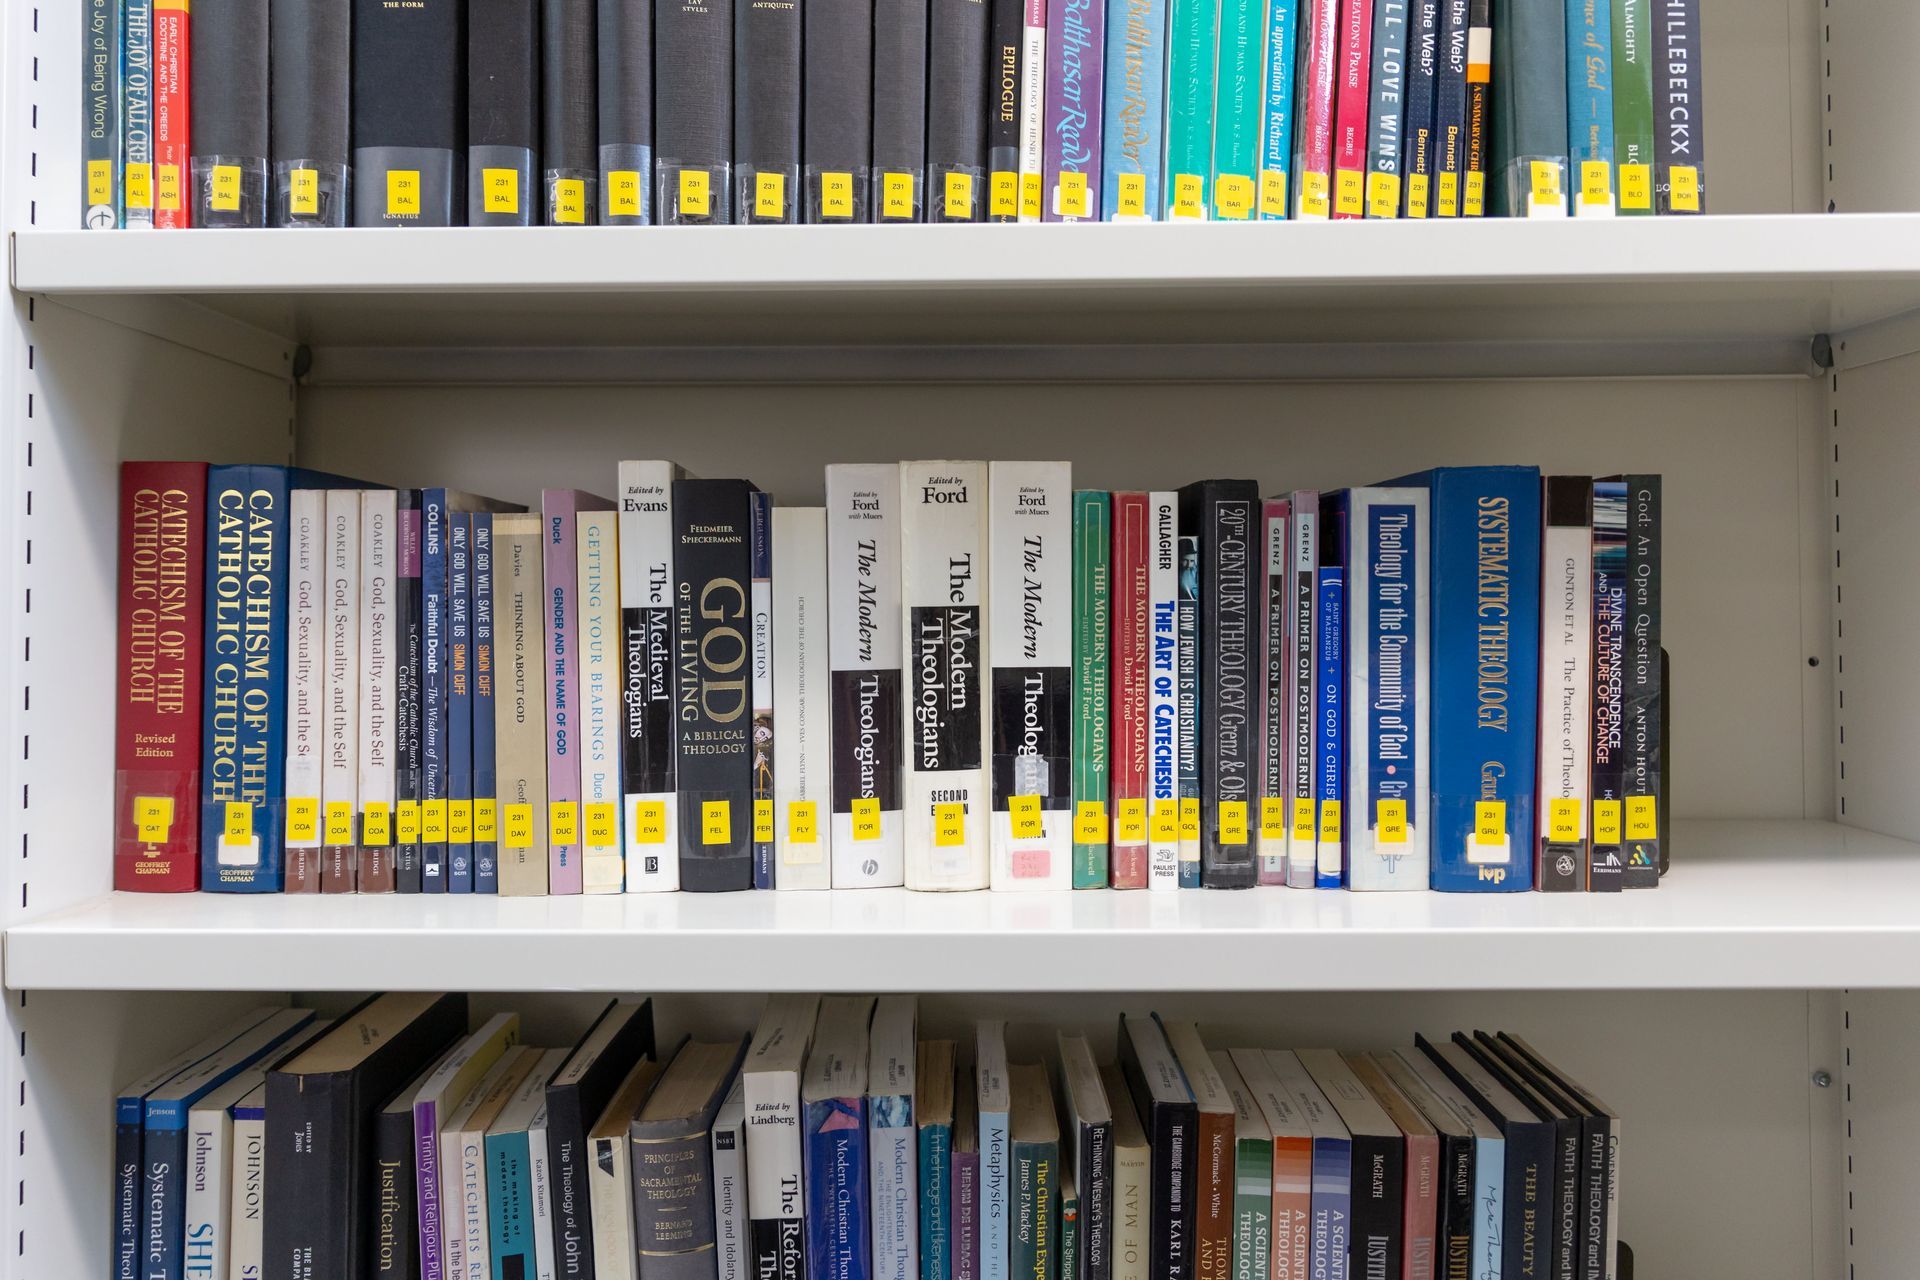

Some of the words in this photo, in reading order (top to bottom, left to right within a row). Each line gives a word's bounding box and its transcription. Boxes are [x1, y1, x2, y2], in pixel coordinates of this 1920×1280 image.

[93, 11, 108, 32] Joy
[169, 16, 177, 46] EARLY
[1276, 6, 1287, 22] An
[1422, 4, 1434, 27] the
[95, 38, 107, 54] of
[159, 17, 168, 62] DOCTRINE
[1272, 26, 1286, 92] appreciation
[1420, 33, 1434, 77] Web?
[92, 55, 108, 90] Being
[159, 64, 168, 82] AND
[159, 85, 168, 100] THE
[169, 50, 177, 95] CHRISTIAN
[1001, 46, 1015, 122] EPILOGUE
[1382, 48, 1400, 103] LOVE
[90, 92, 105, 139] Wrong
[1271, 94, 1282, 108] by
[159, 104, 168, 141] CREEDS
[1269, 112, 1284, 158] Richard
[1378, 115, 1397, 171] WINS
[1417, 129, 1428, 173] Bennett
[397, 196, 413, 204] BAL
[398, 180, 411, 188] 231
[1377, 199, 1390, 207] BEL
[623, 499, 668, 512] Evans
[628, 486, 652, 494] Edited
[655, 486, 664, 496] by
[922, 487, 968, 503] Ford
[132, 489, 159, 600] CATHOLIC
[428, 503, 438, 555] COLLINS
[453, 527, 465, 549] ONLY
[1159, 505, 1171, 570] GALLAGHER
[1272, 528, 1280, 566] GRENZ
[1374, 513, 1409, 578] Theology
[1638, 535, 1649, 556] An
[159, 489, 189, 622] CATECHISM
[216, 489, 244, 655] CATHOLIC
[454, 553, 465, 570] GOD
[588, 526, 600, 607] GETTING
[1477, 496, 1509, 617] SYSTEMATIC
[245, 489, 273, 680] CATECHISM
[454, 572, 465, 596] WILL
[650, 563, 666, 603] The
[680, 582, 690, 602] OF
[950, 553, 971, 603] The
[1094, 564, 1105, 594] THE
[1271, 588, 1279, 598] A
[1380, 584, 1408, 605] for
[1634, 564, 1650, 611] Open
[428, 594, 438, 636] Faithful
[454, 599, 465, 622] SAVE
[680, 606, 692, 634] THE
[1094, 599, 1105, 660] MODERN
[1155, 601, 1175, 632] THE
[1180, 607, 1194, 631] HOW
[1271, 604, 1279, 655] PRIMER
[1380, 608, 1408, 629] the
[158, 630, 186, 661] OF
[454, 625, 465, 637] US
[590, 616, 601, 665] YOUR
[700, 577, 746, 723] GOD
[1634, 613, 1650, 685] Question
[131, 609, 156, 703] CHURCH
[428, 639, 437, 674] Doubt
[454, 644, 465, 671] SIMON
[650, 609, 668, 701] Medieval
[950, 609, 972, 710] Modern
[1155, 636, 1175, 671] ART
[1180, 635, 1194, 673] JEWISH
[1271, 660, 1279, 681] ON
[1374, 634, 1408, 711] Community
[157, 669, 184, 714] THE
[454, 675, 465, 696] CUFF
[624, 624, 647, 738] Theologians
[680, 639, 698, 722] LIVING
[915, 617, 945, 768] Theologians
[1155, 677, 1172, 699] OF
[1180, 677, 1194, 690] IS
[1326, 685, 1336, 704] ON
[1477, 622, 1509, 733] THEOLOGY
[243, 689, 269, 733] OF
[591, 672, 605, 761] BEARINGS
[1093, 664, 1105, 773] THEOLOGIANS
[1180, 690, 1194, 772] CHRISTIANITY?
[1326, 709, 1336, 737] GOD
[1380, 712, 1408, 731] of
[135, 734, 175, 744] Revised
[136, 748, 174, 757] Edition
[212, 668, 238, 804] CHURCH
[683, 731, 691, 741] A
[694, 730, 745, 741] BIBLICAL
[683, 744, 746, 754] THEOLOGY
[1155, 703, 1175, 799] CATECHESIS
[1326, 742, 1336, 750] &
[1380, 733, 1408, 760] God
[241, 740, 268, 808] THE
[1326, 755, 1336, 801] CHRIST
[1479, 865, 1505, 884] ivp
[148, 1107, 176, 1118] Jenson
[751, 1116, 795, 1126] Lindberg
[194, 1132, 212, 1192] Johnson
[421, 1135, 433, 1174] Trinity
[987, 1129, 1004, 1218] Metaphysics
[1213, 1134, 1221, 1185] McCormack
[1565, 1138, 1576, 1173] FAITH
[246, 1135, 261, 1220] JOHNSON
[425, 1177, 433, 1198] and
[781, 1174, 798, 1214] The
[1020, 1159, 1032, 1191] James
[1372, 1154, 1383, 1199] McGRATH
[1525, 1164, 1537, 1202] THE
[151, 1163, 168, 1263] Systematic
[380, 1160, 401, 1272] Justification
[465, 1145, 480, 1252] CATECHESIS
[721, 1176, 733, 1217] Identity
[1021, 1193, 1030, 1201] P.
[1211, 1193, 1219, 1218] White
[1562, 1177, 1573, 1245] THEOLOGY
[425, 1202, 437, 1253] Religious
[724, 1220, 733, 1241] and
[1018, 1202, 1030, 1243] Mackey
[1170, 1220, 1181, 1260] KARL
[1523, 1209, 1536, 1276] BEAUTY
[565, 1231, 578, 1274] John
